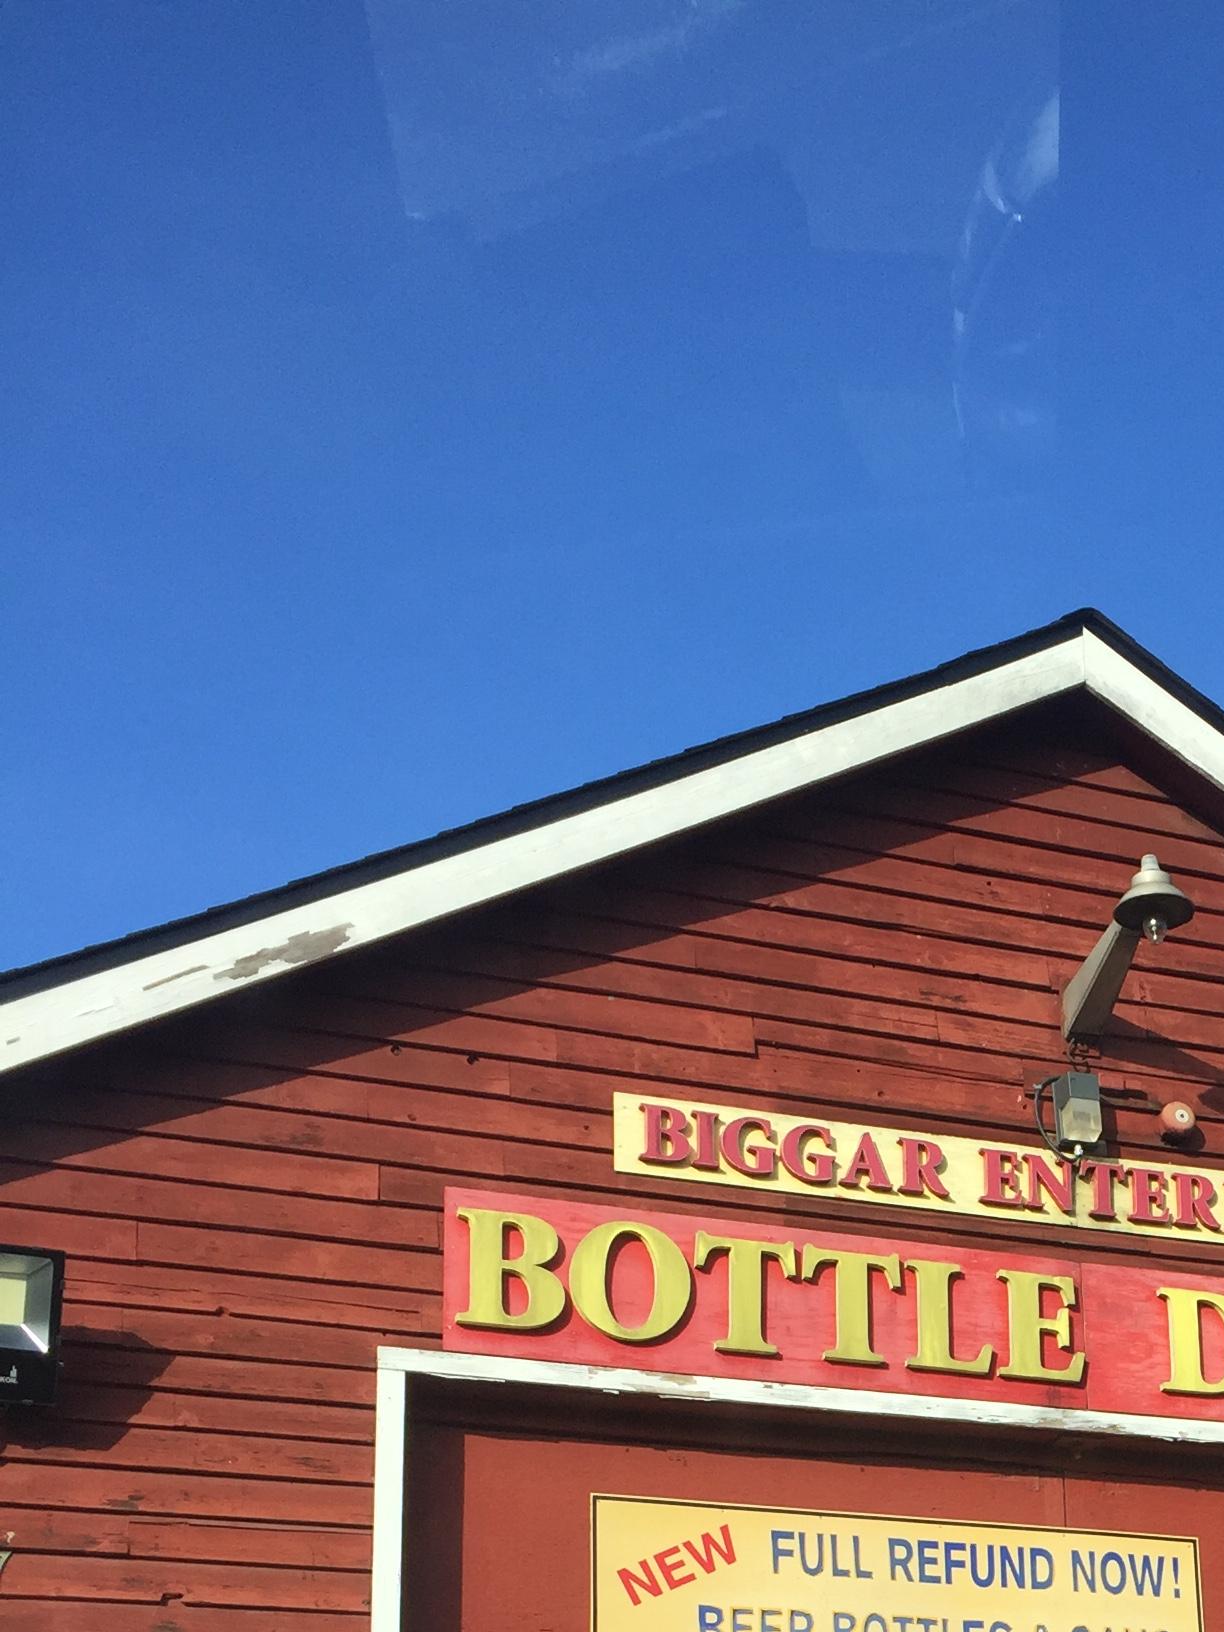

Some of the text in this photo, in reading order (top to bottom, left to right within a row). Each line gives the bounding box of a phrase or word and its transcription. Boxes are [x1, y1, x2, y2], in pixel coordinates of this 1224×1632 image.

[638, 1103, 950, 1198] BIGGAR
[454, 1207, 1086, 1384] BOTTLE
[616, 1524, 738, 1606] NEW
[769, 1529, 1183, 1599] FULL REFUND NOW!
